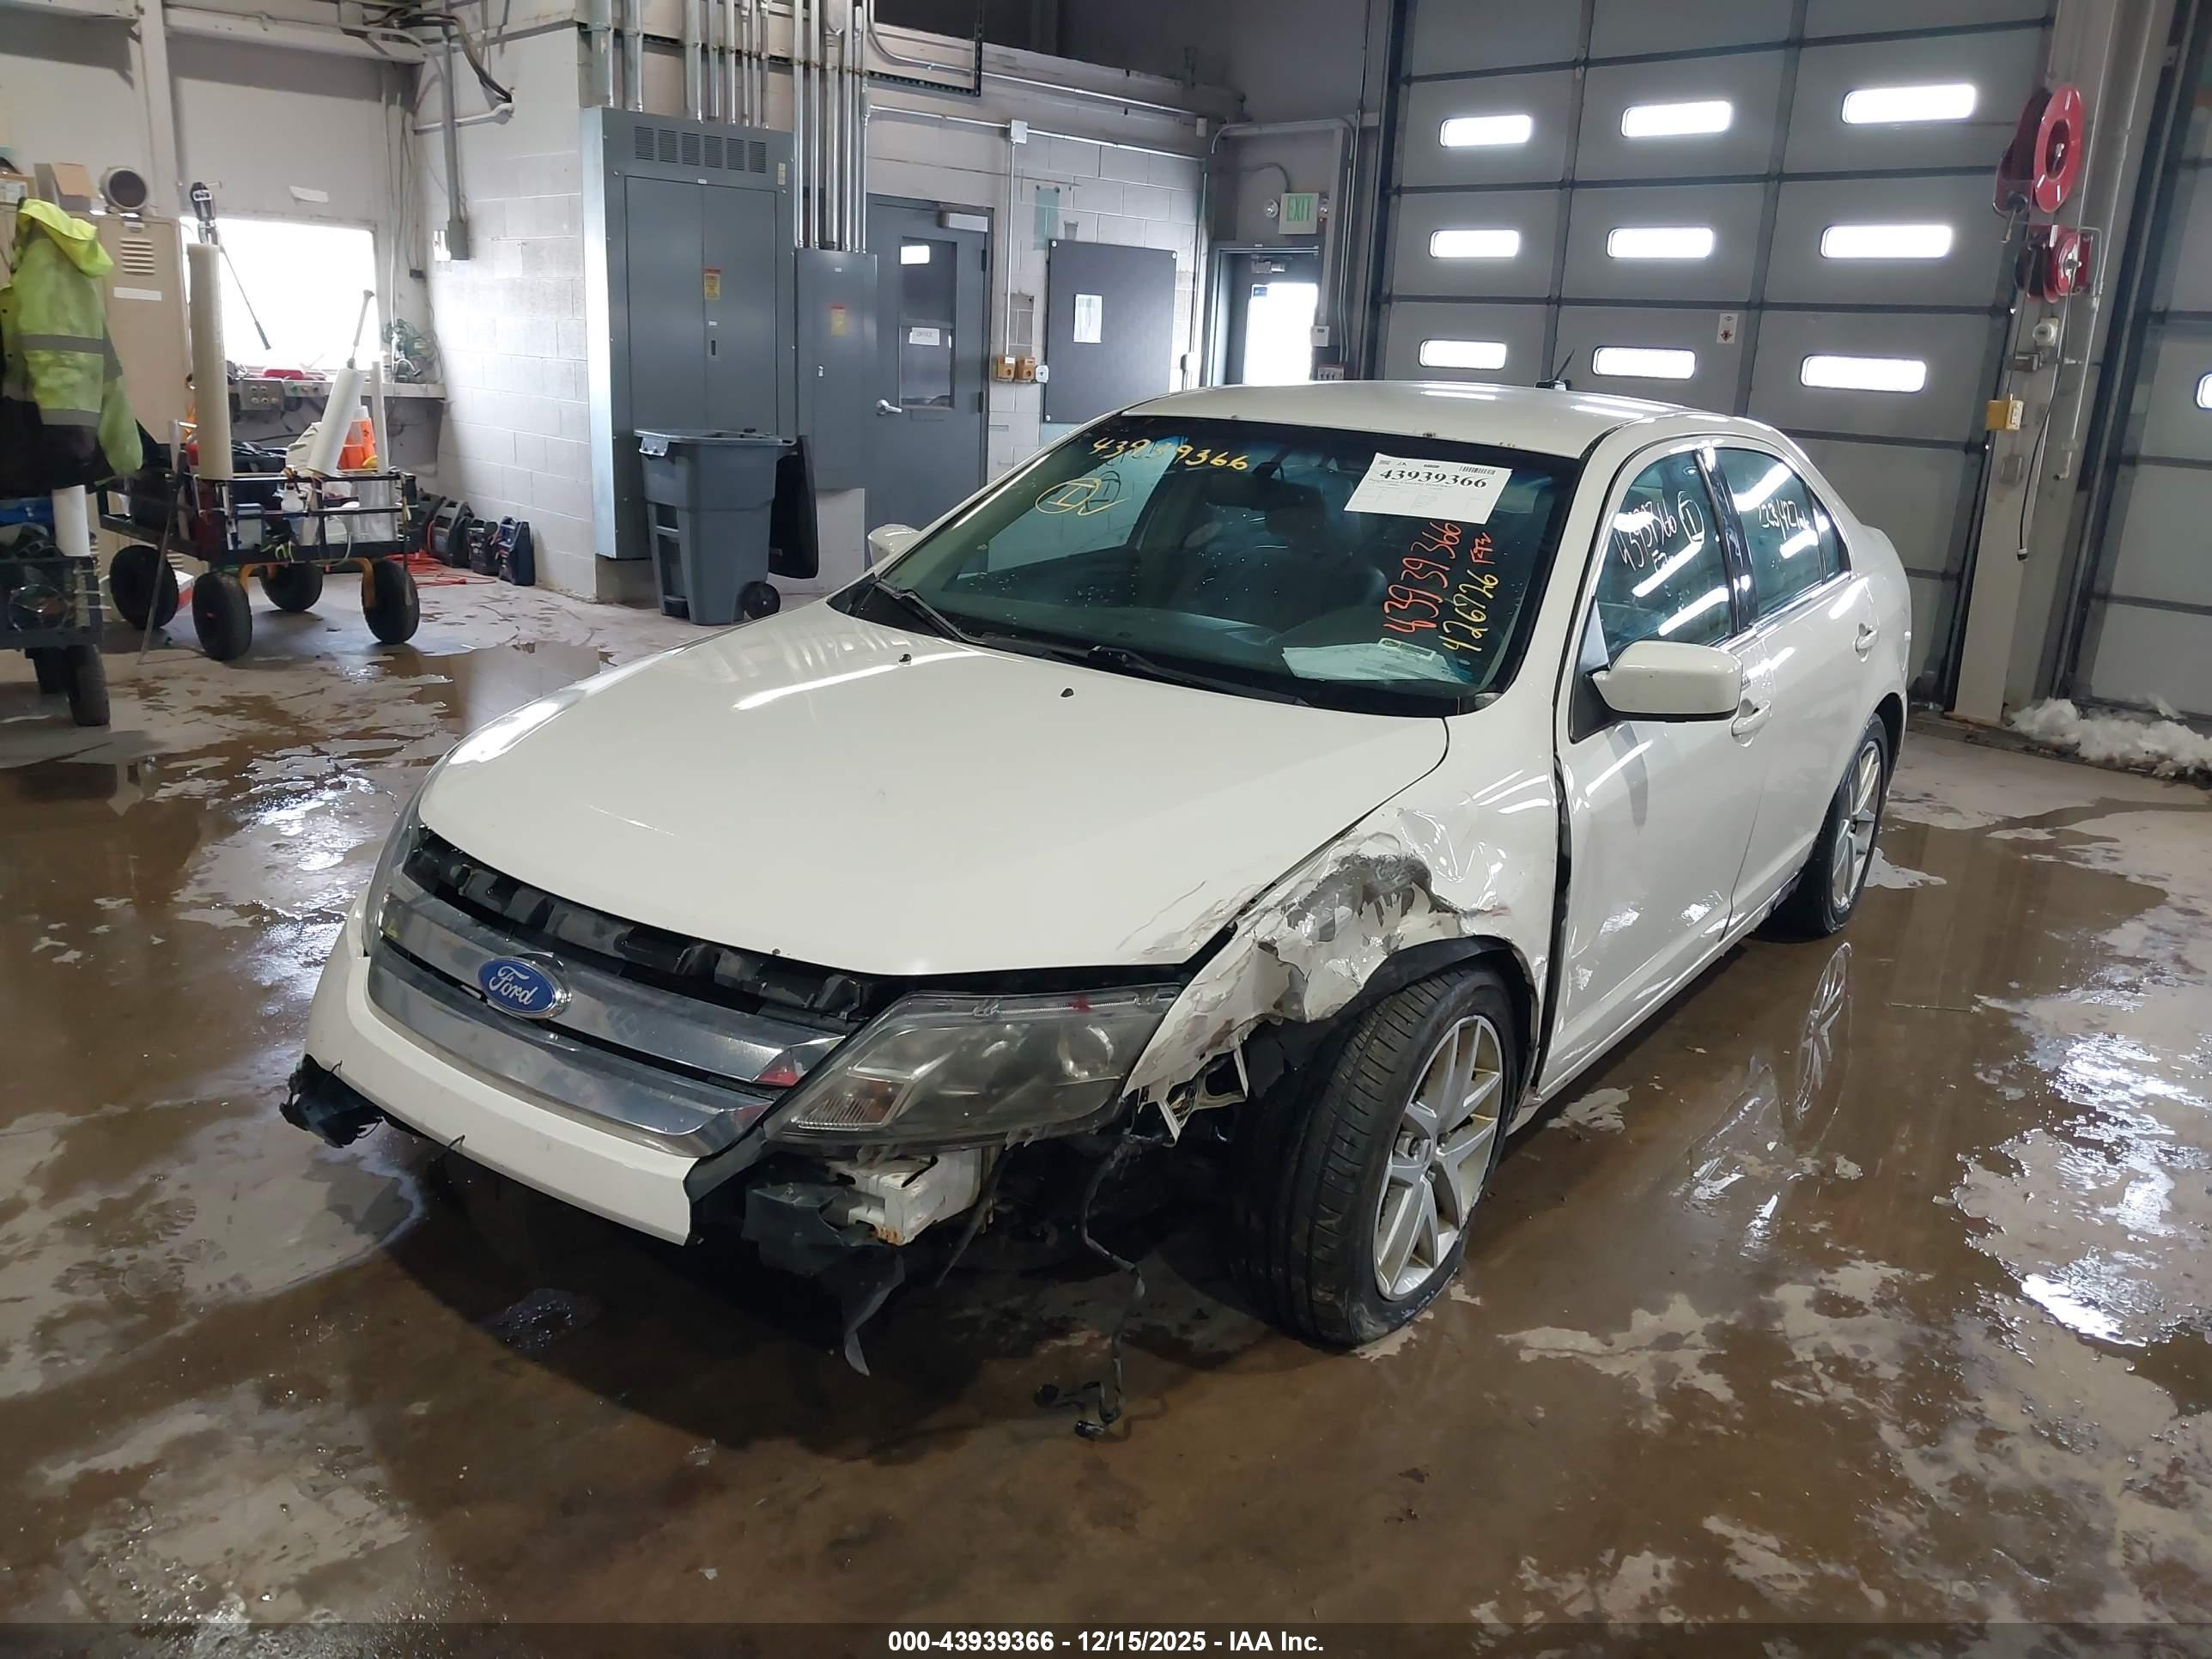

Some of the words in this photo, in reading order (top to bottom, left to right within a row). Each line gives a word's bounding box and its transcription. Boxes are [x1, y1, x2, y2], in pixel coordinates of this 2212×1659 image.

[1286, 196, 1313, 222] EXIT
[1379, 468, 1491, 489] 43939366
[1382, 521, 1462, 633] 43939366
[489, 965, 538, 1005] Ford
